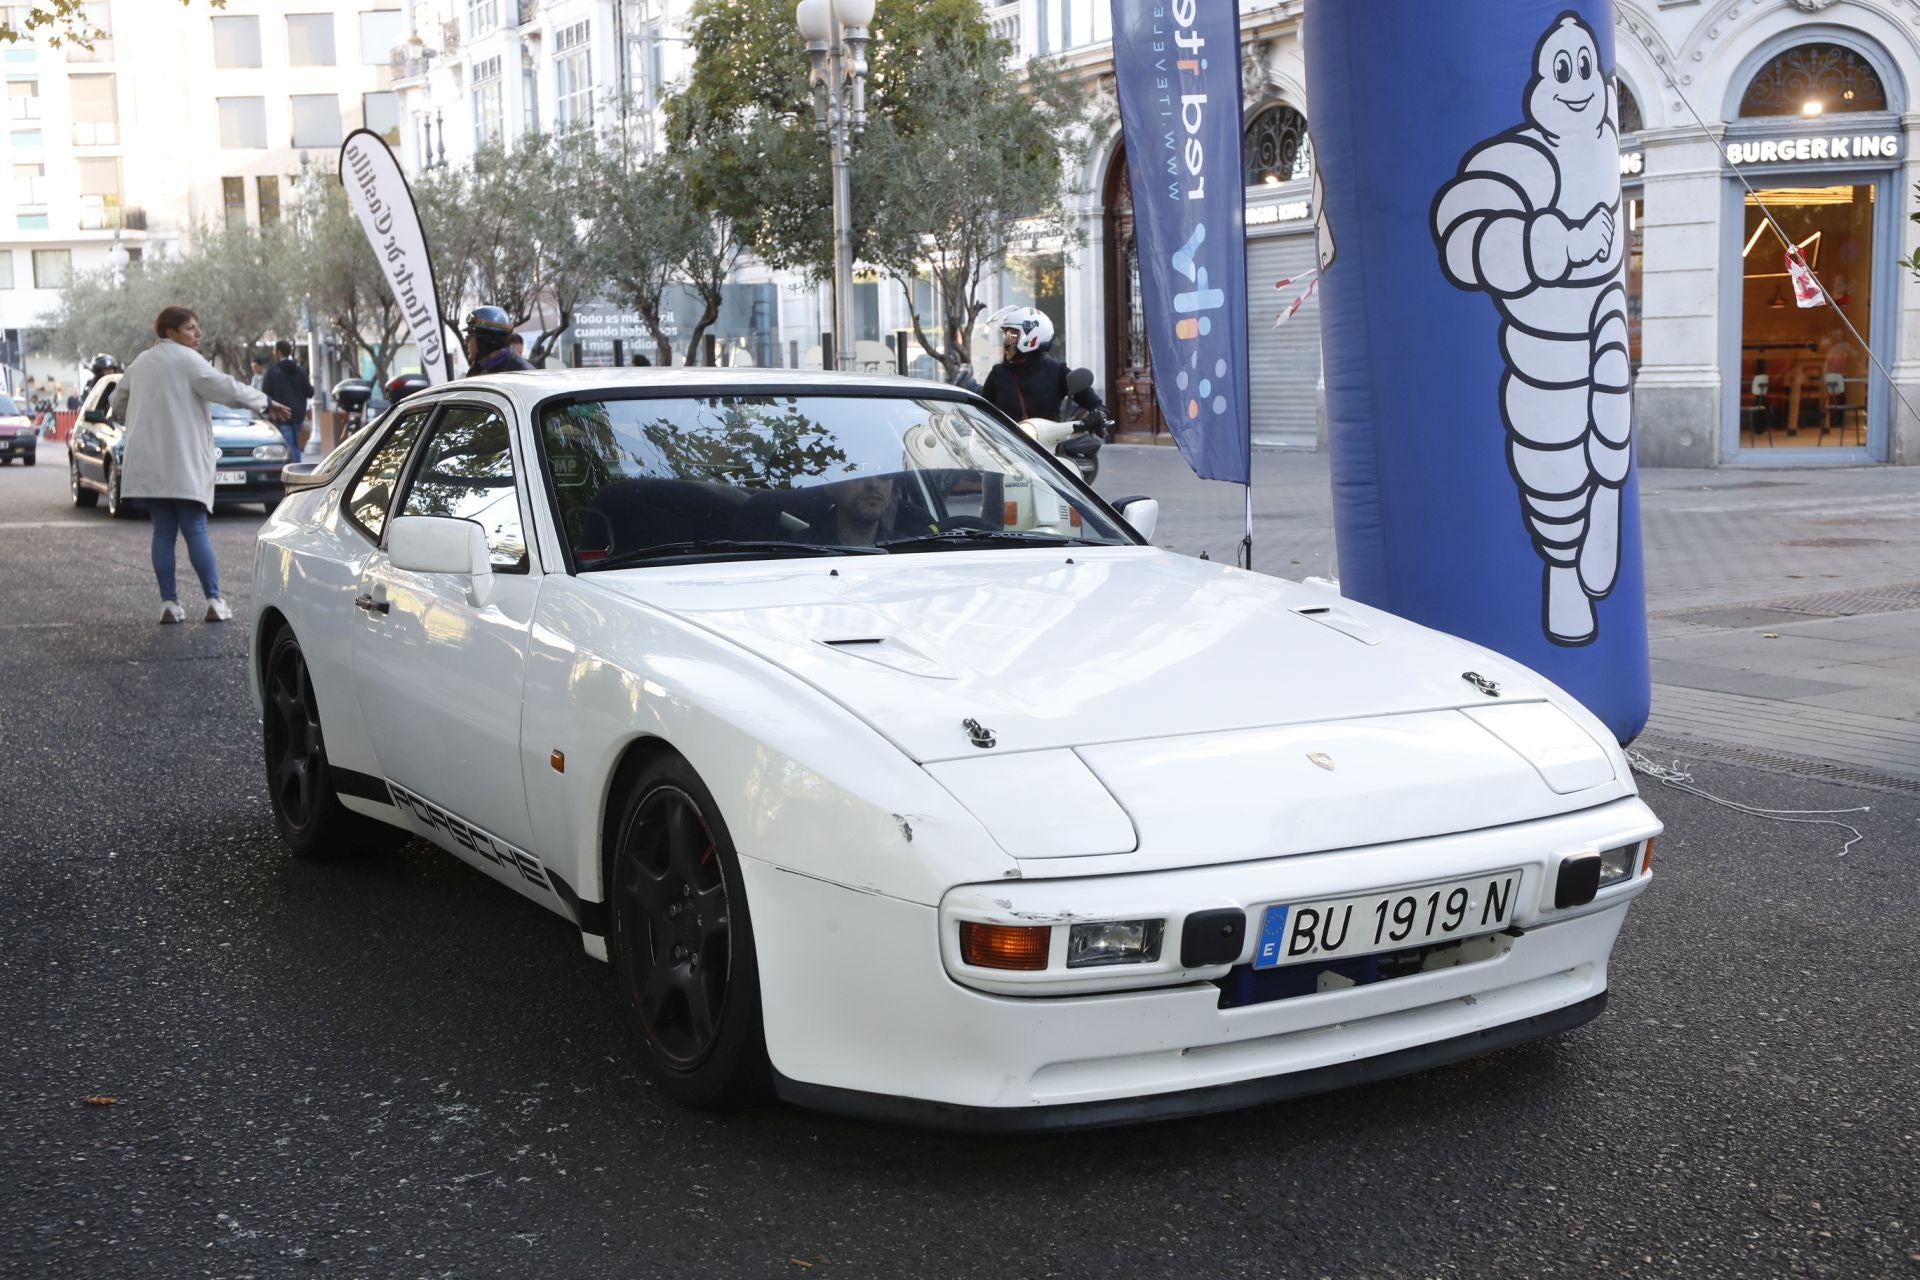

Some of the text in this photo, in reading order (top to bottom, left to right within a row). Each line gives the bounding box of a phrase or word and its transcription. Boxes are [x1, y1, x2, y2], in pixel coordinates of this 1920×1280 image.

[1727, 135, 1898, 164] BURGER KING
[1619, 152, 1642, 174] NG
[573, 313, 603, 324] Todo
[605, 315, 619, 323] es
[621, 311, 643, 323] má
[574, 326, 617, 337] cuando
[589, 339, 628, 350] miso
[1373, 887, 1469, 945] 1919
[1480, 878, 1512, 926] N
